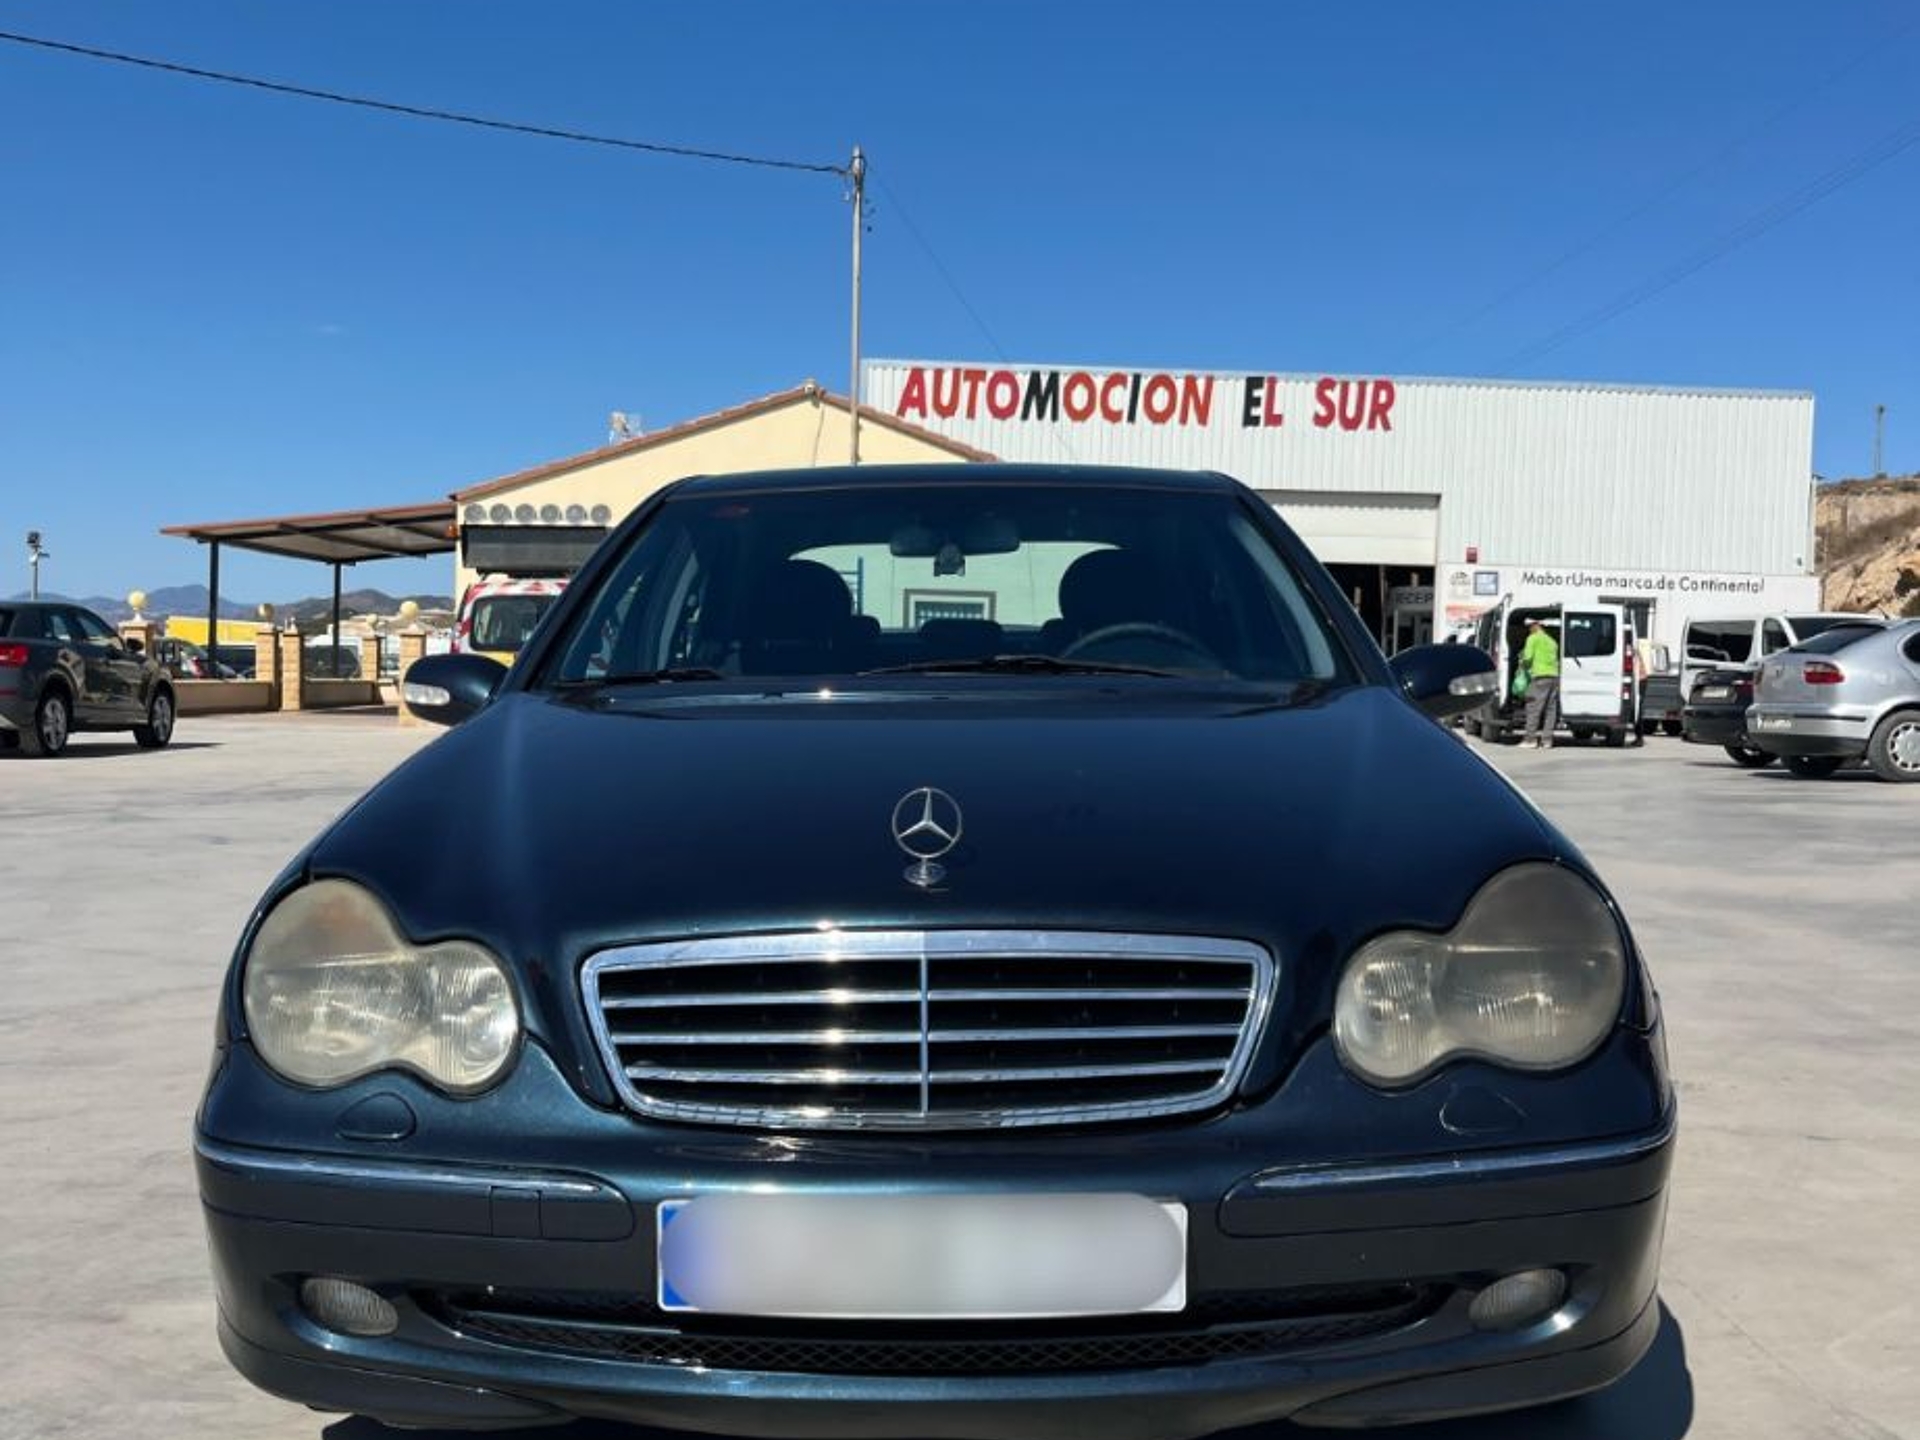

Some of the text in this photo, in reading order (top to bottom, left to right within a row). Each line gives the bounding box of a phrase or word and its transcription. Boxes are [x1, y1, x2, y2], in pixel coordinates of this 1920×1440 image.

[896, 367, 1395, 432] AUTOMOCION EL SUR
[1679, 576, 1765, 594] Continental
